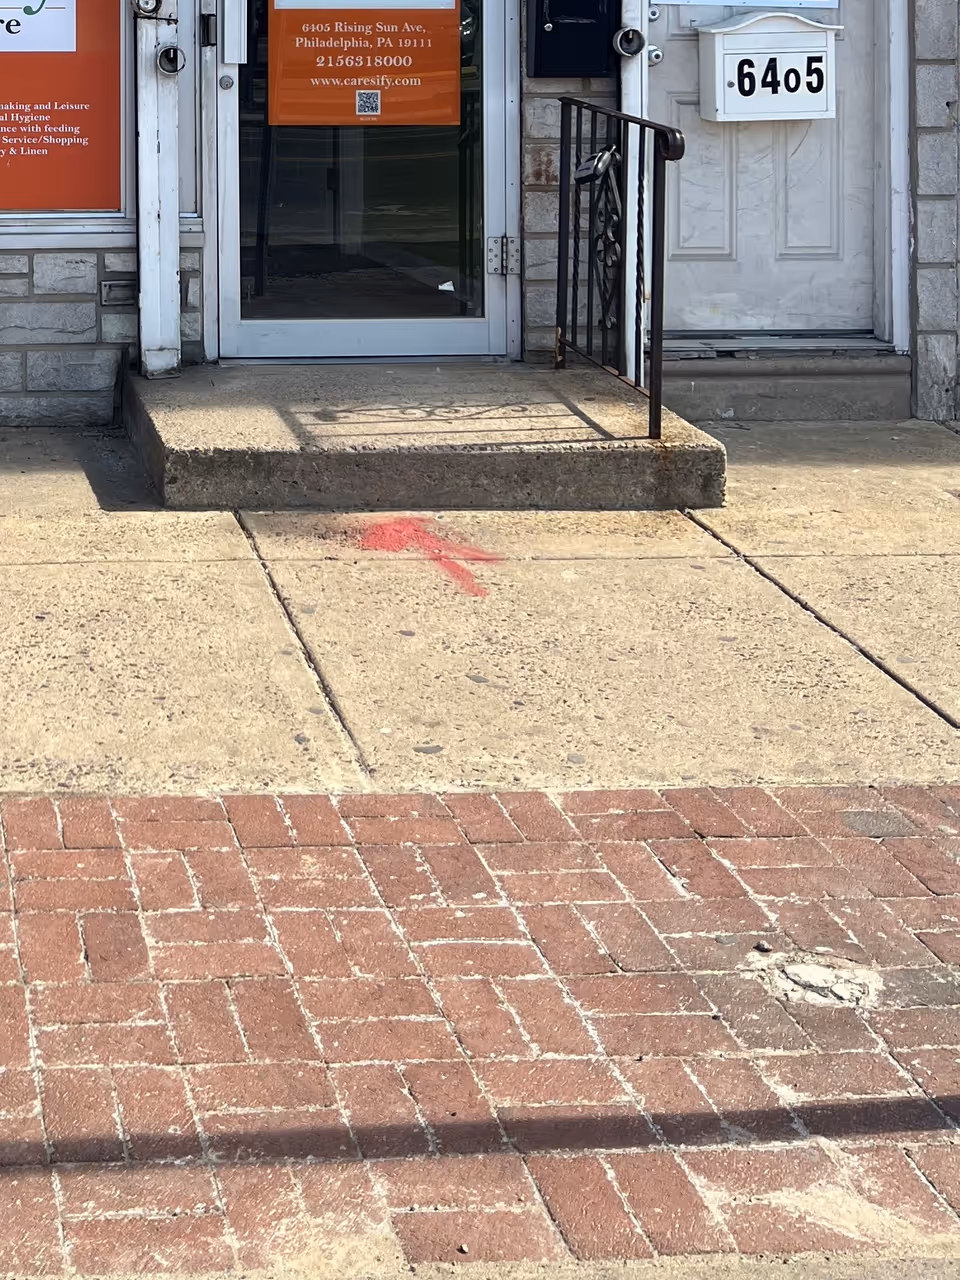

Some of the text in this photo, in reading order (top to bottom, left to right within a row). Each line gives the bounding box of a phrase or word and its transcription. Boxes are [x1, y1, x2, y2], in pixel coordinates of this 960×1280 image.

[302, 22, 426, 35] 6405 Rising Sun Ave,
[295, 38, 432, 51] Philadelphia, PA 19111
[316, 56, 413, 67] 2156318000
[737, 56, 824, 97] 6405
[310, 76, 421, 89] www.caresify.com
[33, 102, 51, 110] and
[54, 102, 90, 110] Leisure
[11, 113, 50, 123] Hygiene
[44, 124, 80, 134] feeding
[2, 135, 88, 146] Service/Shopping
[20, 147, 48, 155] Linen
